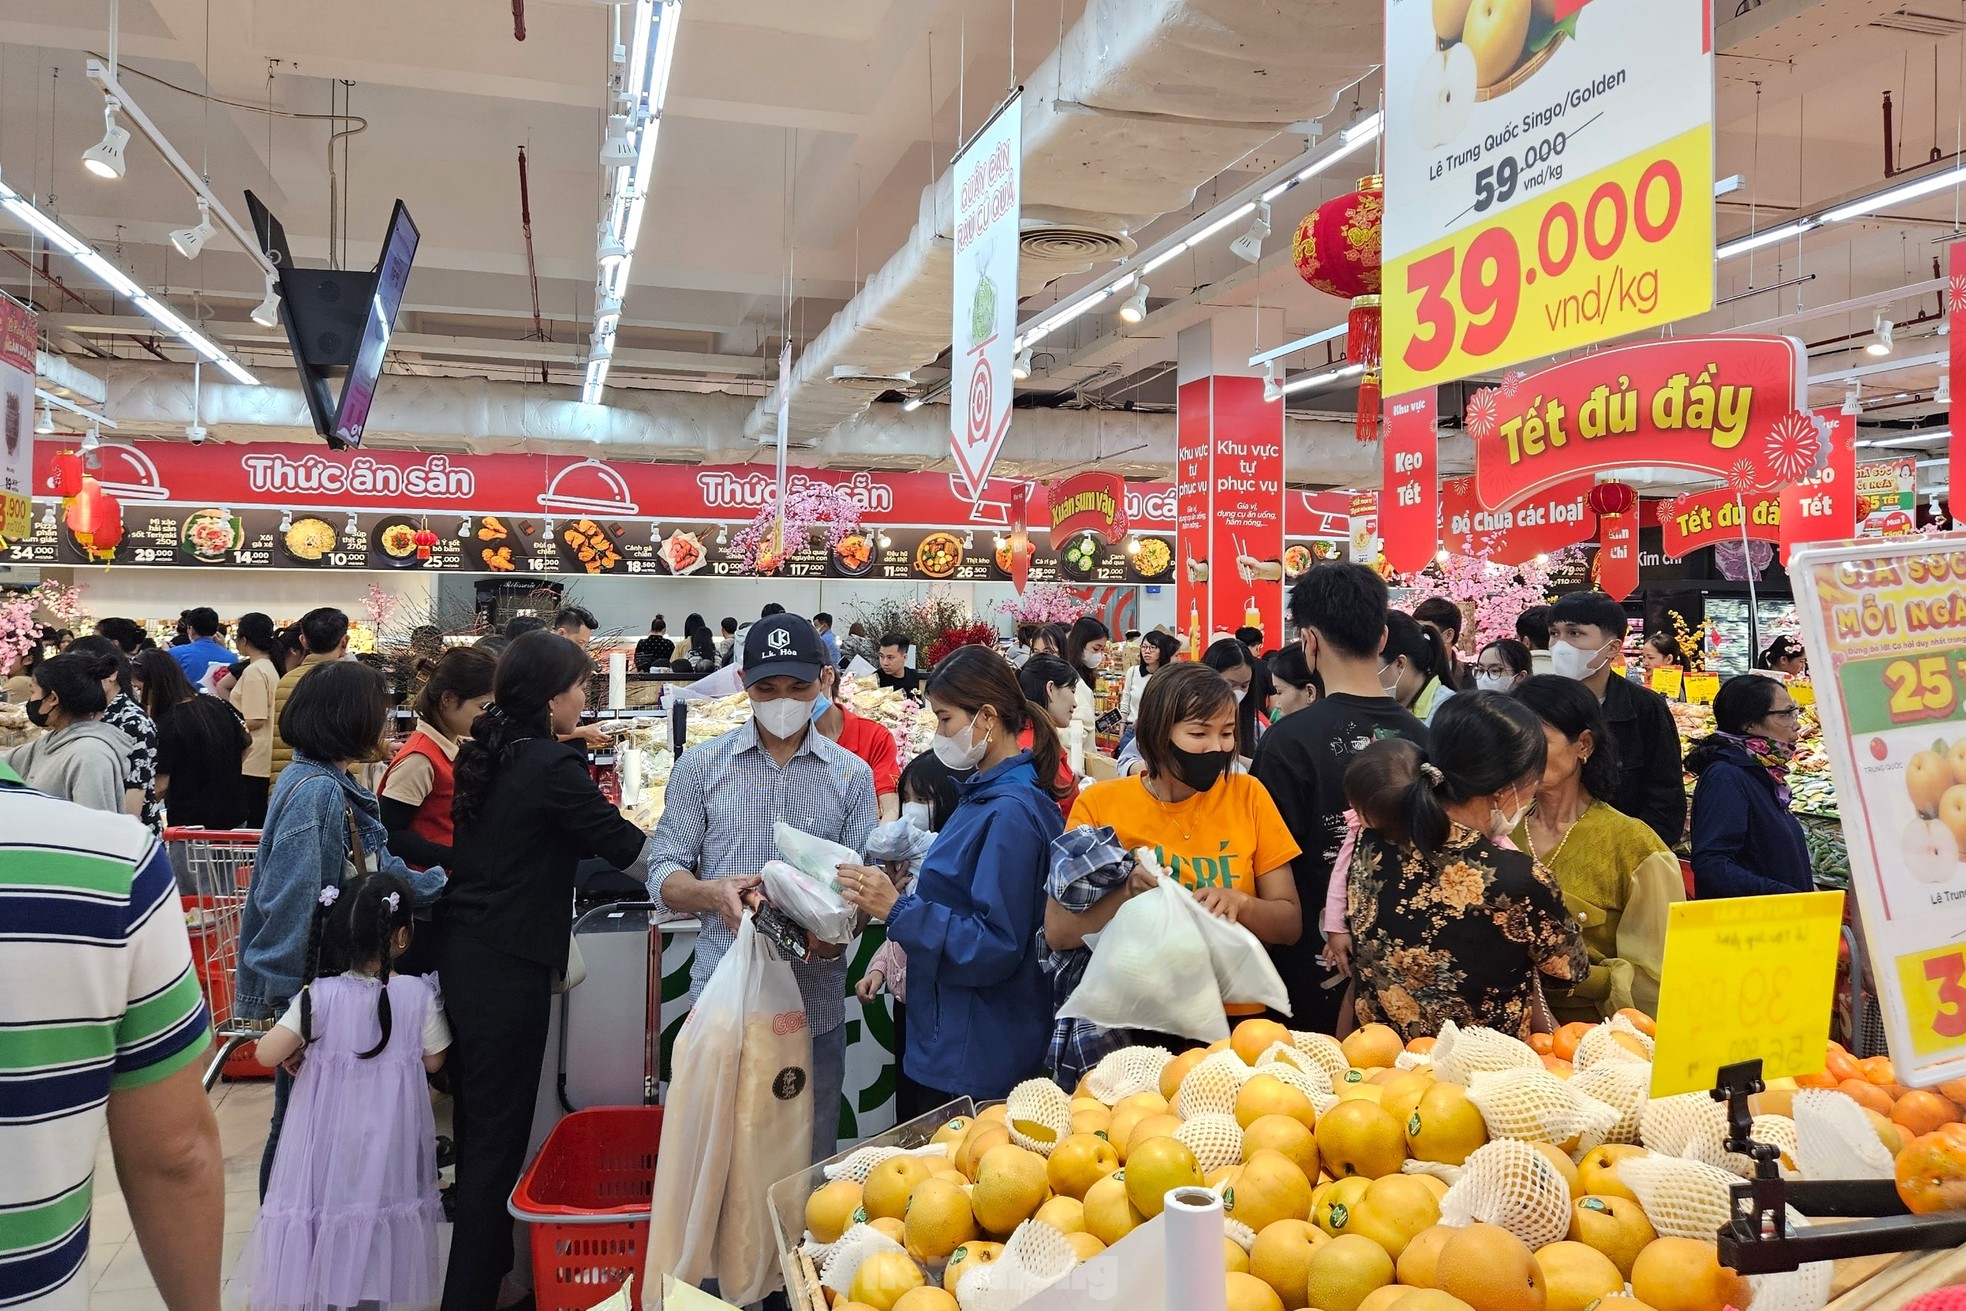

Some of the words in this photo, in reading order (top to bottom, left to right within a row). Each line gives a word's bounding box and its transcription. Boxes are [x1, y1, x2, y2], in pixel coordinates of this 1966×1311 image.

[1429, 160, 1443, 181] Lê
[1446, 142, 1481, 172] Trung
[1485, 121, 1519, 152] Quốc
[1522, 68, 1627, 133] Singo/Golden
[1473, 131, 1567, 212] 59.000
[1523, 163, 1564, 191] vnd/kg
[956, 211, 975, 254] RAU
[1402, 159, 1683, 372] 39.000
[1545, 265, 1659, 332] vnd/kg
[1393, 404, 1410, 417] Khu
[1411, 399, 1426, 413] vực
[1500, 393, 1568, 465] Tết
[1578, 374, 1639, 440] đủ
[1652, 362, 1753, 450] đầy
[1179, 447, 1193, 461] Khu
[1194, 444, 1208, 460] vực
[1217, 440, 1247, 455] Khu
[1251, 443, 1279, 460] vực
[1189, 463, 1198, 479] tự
[1240, 459, 1257, 477] tự
[1395, 451, 1423, 475] Kẹo
[1872, 464, 1892, 477] SỐC
[244, 457, 344, 491] Thức
[350, 456, 400, 492] ăn
[404, 456, 473, 495] sẵn
[700, 473, 778, 507] Thức
[839, 473, 892, 511] sẵn
[1179, 481, 1196, 498] phục
[1197, 481, 1207, 495] vụ
[1217, 476, 1256, 494] phục
[1259, 480, 1278, 495] vụ
[1397, 480, 1421, 507] Tết
[1052, 497, 1075, 528] Xuân
[1075, 491, 1096, 512] sum
[1096, 485, 1116, 525] vầy
[1237, 502, 1249, 510] Gia
[1799, 492, 1833, 517] Tết
[1882, 493, 1900, 505] TẾT
[1217, 509, 1236, 518] dụng
[1452, 509, 1471, 535] Đồ
[1474, 511, 1513, 532] Chua
[1517, 504, 1546, 527] các
[1550, 497, 1584, 532] loại
[1676, 504, 1712, 537] Tết
[1752, 494, 1781, 525] đầ
[1886, 517, 1900, 526] Mua
[34, 522, 57, 530] Pizza
[131, 530, 145, 538] sốt
[40, 536, 58, 544] giác
[155, 538, 177, 547] 250g
[347, 543, 367, 551] 270g
[10, 546, 54, 560] 34.000
[134, 548, 173, 561] 29.000
[233, 551, 269, 564] 14.000
[328, 553, 366, 566] 10.000
[1610, 545, 1628, 559] Chi
[1638, 551, 1660, 567] Kim
[423, 556, 460, 568] 25.000
[528, 558, 559, 571] 16.000
[626, 560, 656, 573] 18.500
[790, 563, 825, 575] 117.000
[884, 565, 908, 576] 11.000
[956, 566, 987, 578] 26.500
[1028, 567, 1056, 579] 25.000
[1097, 567, 1123, 579] 12.000
[1836, 593, 1897, 639] MỖI
[1905, 590, 1966, 632] NGÀ
[1885, 656, 1957, 721] 25
[1864, 765, 1884, 774] TRUNG
[1885, 761, 1903, 773] QUỐC
[1931, 892, 1942, 905] Lê
[1945, 889, 1966, 904] Trun
